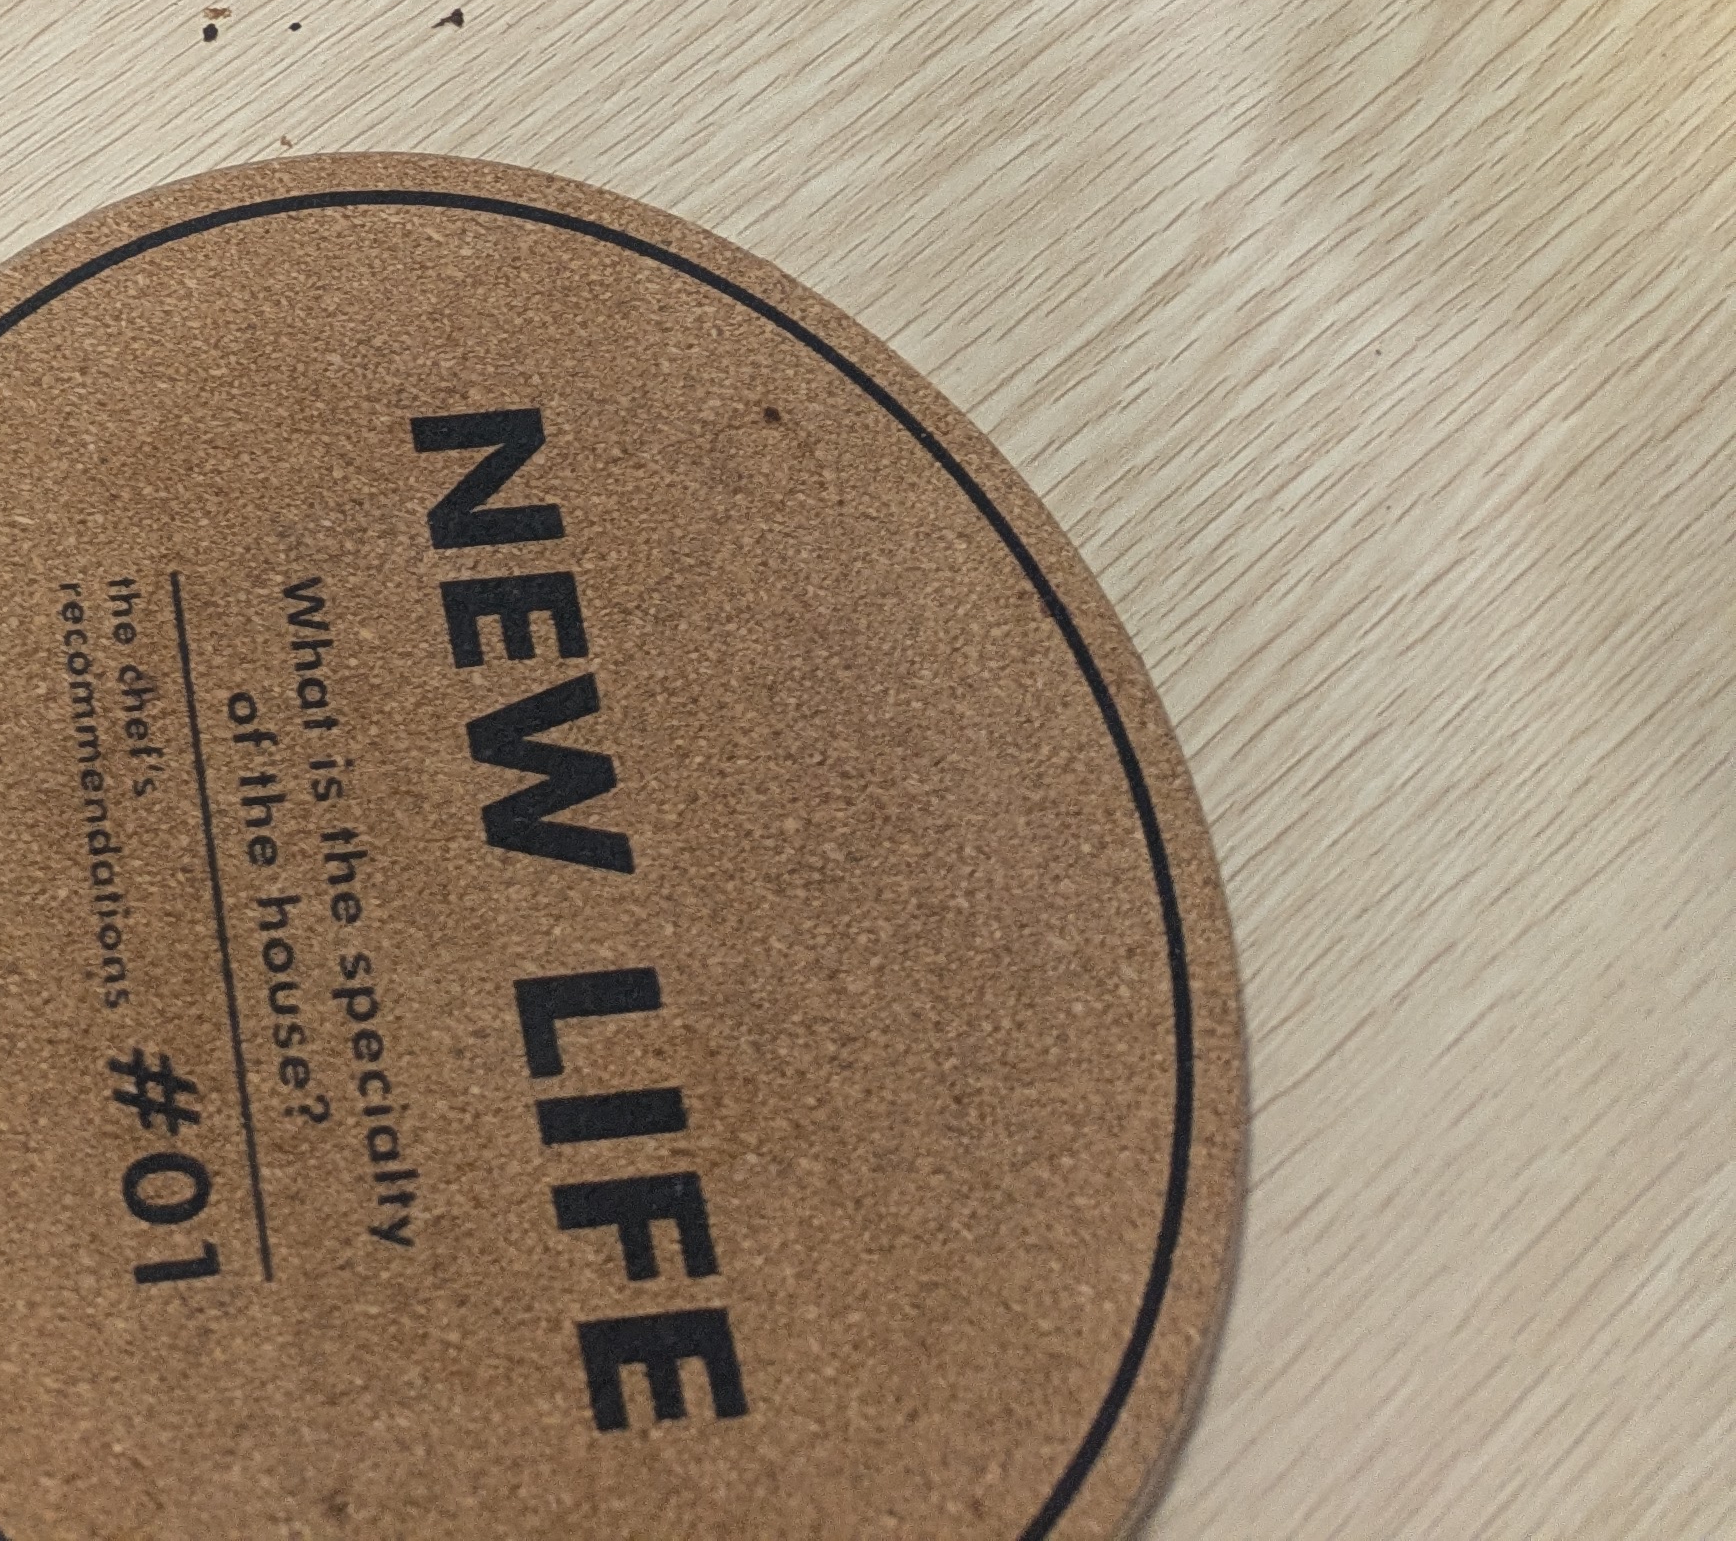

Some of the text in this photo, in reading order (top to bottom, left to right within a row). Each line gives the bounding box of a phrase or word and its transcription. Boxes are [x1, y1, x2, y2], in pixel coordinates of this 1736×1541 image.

[59, 582, 130, 1010] recommendations
[107, 577, 166, 800] the chef's
[226, 690, 332, 1125] of the house?
[281, 575, 420, 1249] What is the specialty
[408, 407, 750, 1433] NEW LIFE
[106, 1046, 222, 1286] #01
